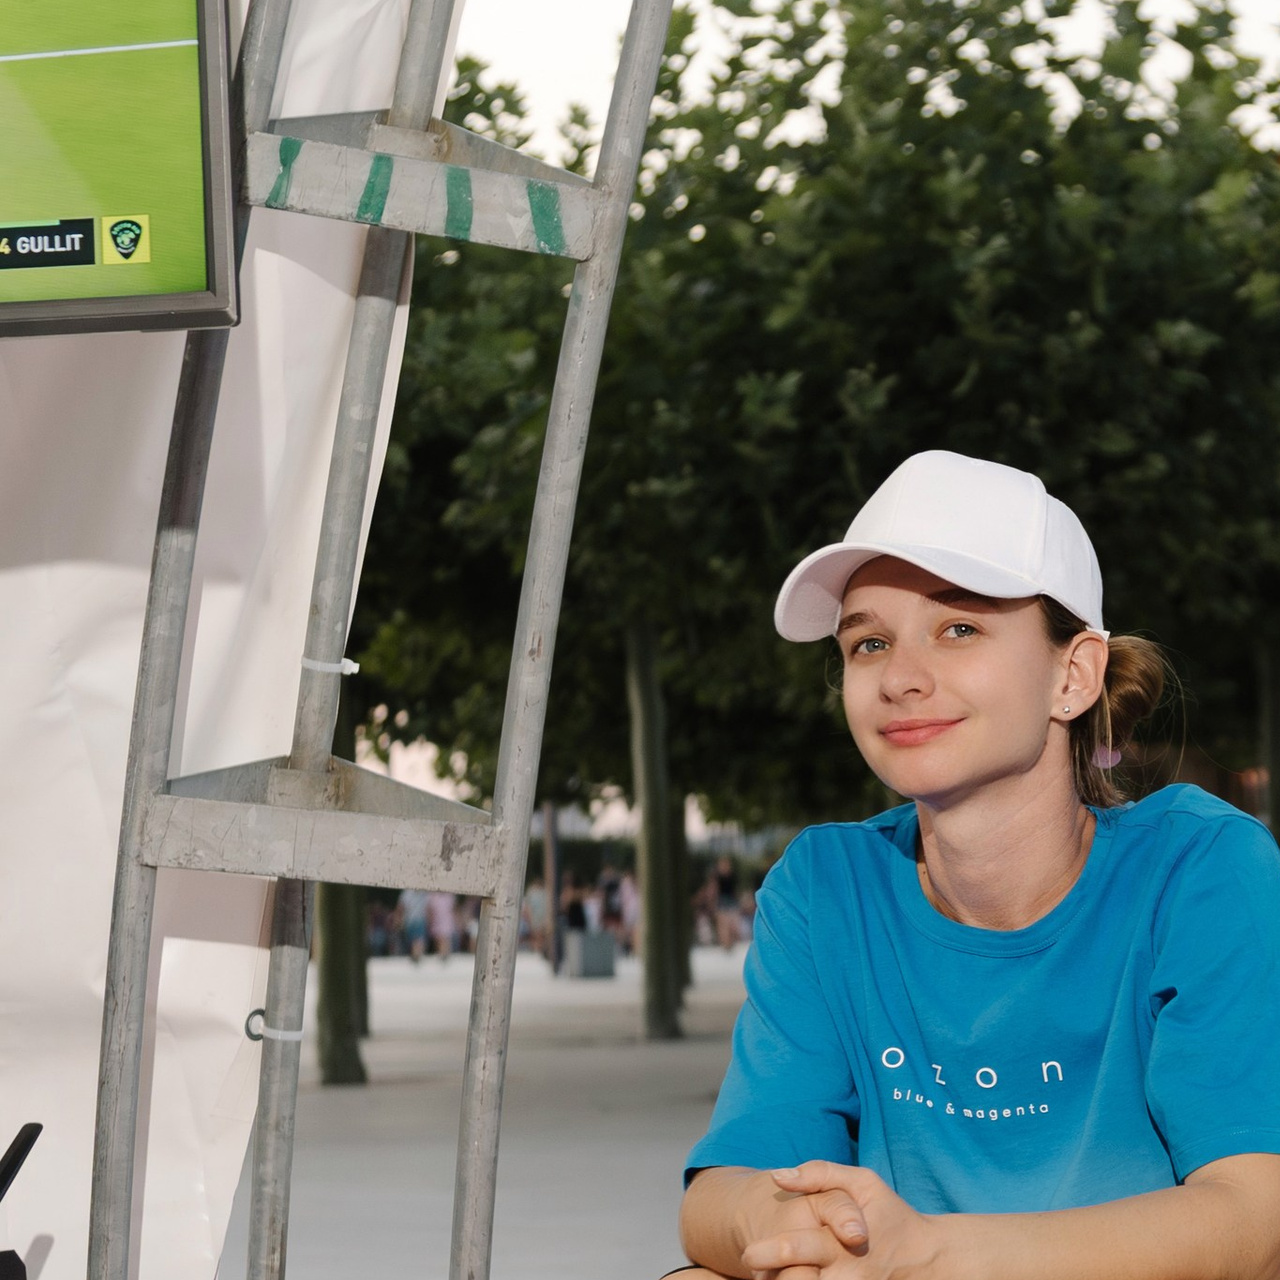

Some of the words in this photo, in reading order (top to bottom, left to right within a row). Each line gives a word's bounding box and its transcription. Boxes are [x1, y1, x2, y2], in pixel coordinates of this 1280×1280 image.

[16, 233, 84, 254] GULLIT
[881, 1046, 1064, 1089] ozon
[893, 1088, 934, 1108] blue
[945, 1102, 955, 1115] &
[963, 1102, 1050, 1121] magenta
